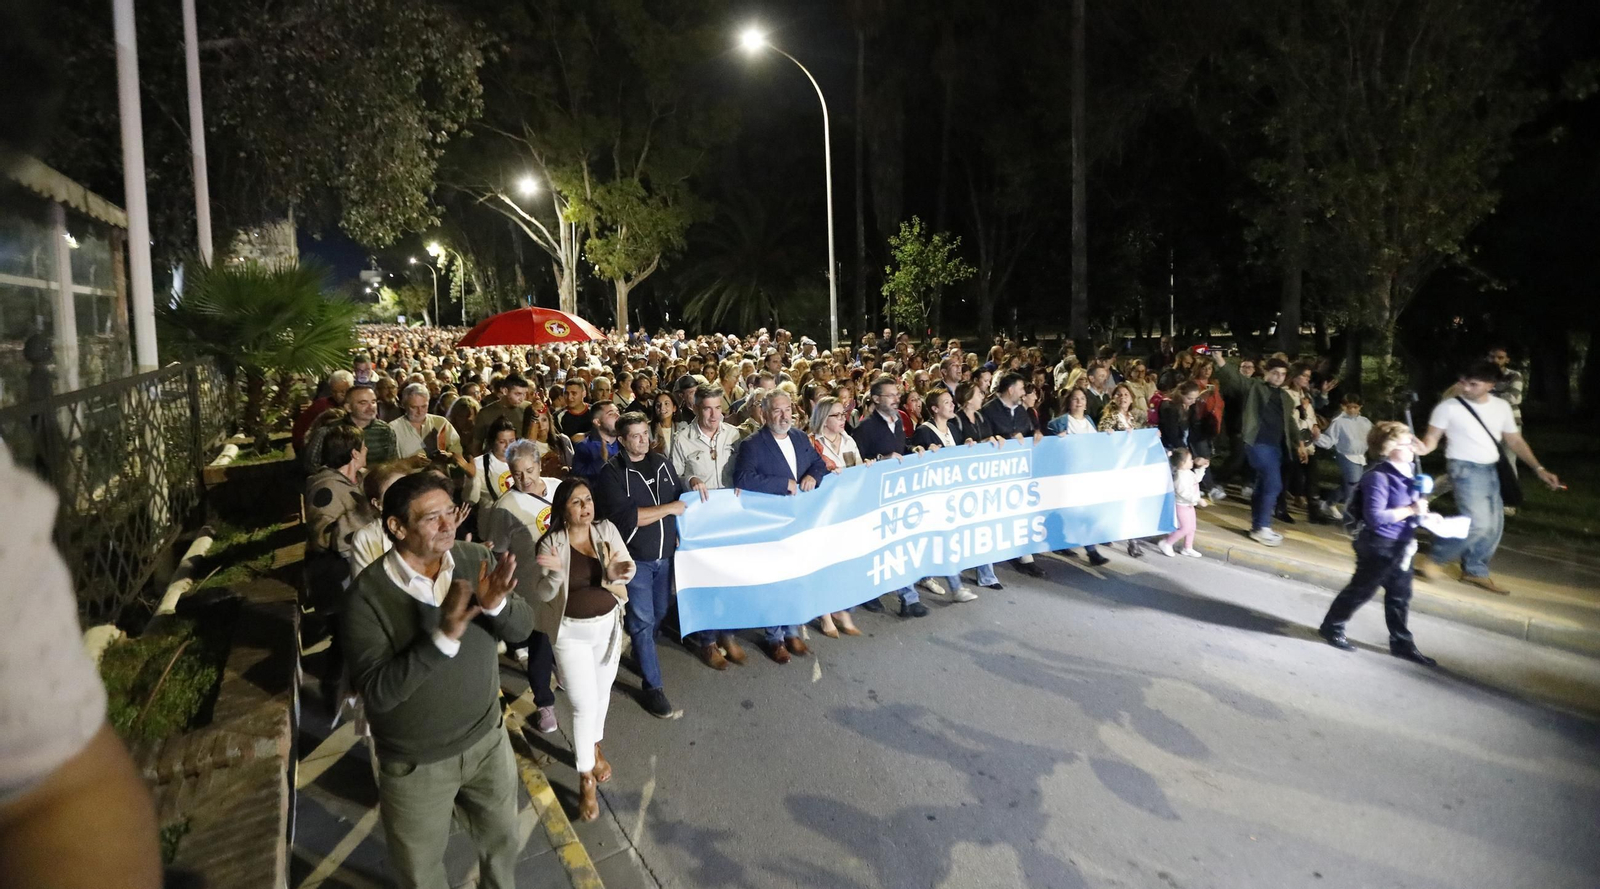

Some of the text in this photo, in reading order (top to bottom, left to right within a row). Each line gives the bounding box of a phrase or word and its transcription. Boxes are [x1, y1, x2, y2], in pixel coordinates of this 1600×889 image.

[883, 456, 1029, 499] LA LÍNEA CUENTA
[875, 481, 1041, 540] NO SOMOS
[867, 516, 1048, 586] INVISIBLES
